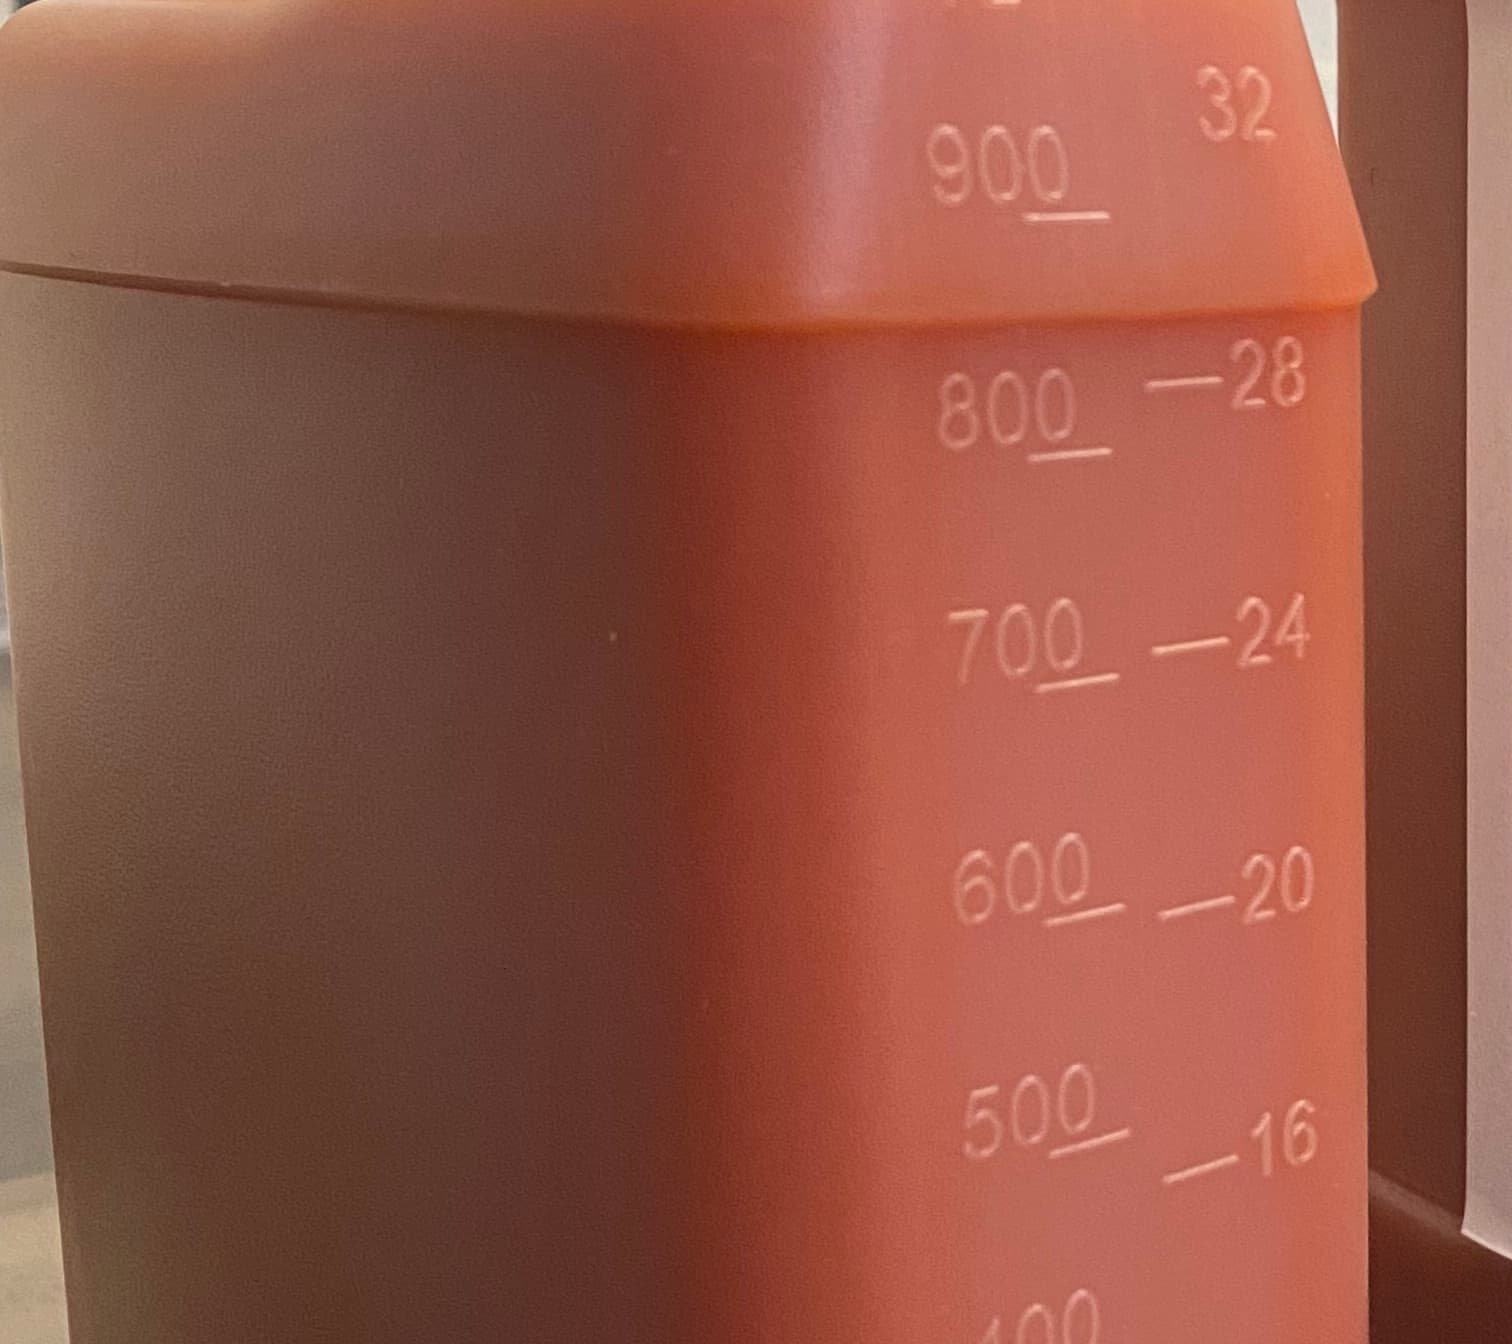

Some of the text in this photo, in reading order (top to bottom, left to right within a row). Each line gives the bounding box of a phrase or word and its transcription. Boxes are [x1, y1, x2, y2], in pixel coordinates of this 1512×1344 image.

[1197, 65, 1279, 143] 32
[926, 123, 1071, 205] 900
[938, 367, 1076, 449] 800
[1230, 335, 1306, 410] 28
[947, 596, 1083, 685] 700
[1236, 592, 1311, 668] 24
[953, 831, 1092, 926] 600
[1241, 844, 1314, 925] 20
[962, 1063, 1096, 1158] 500
[1250, 1098, 1319, 1178] 16
